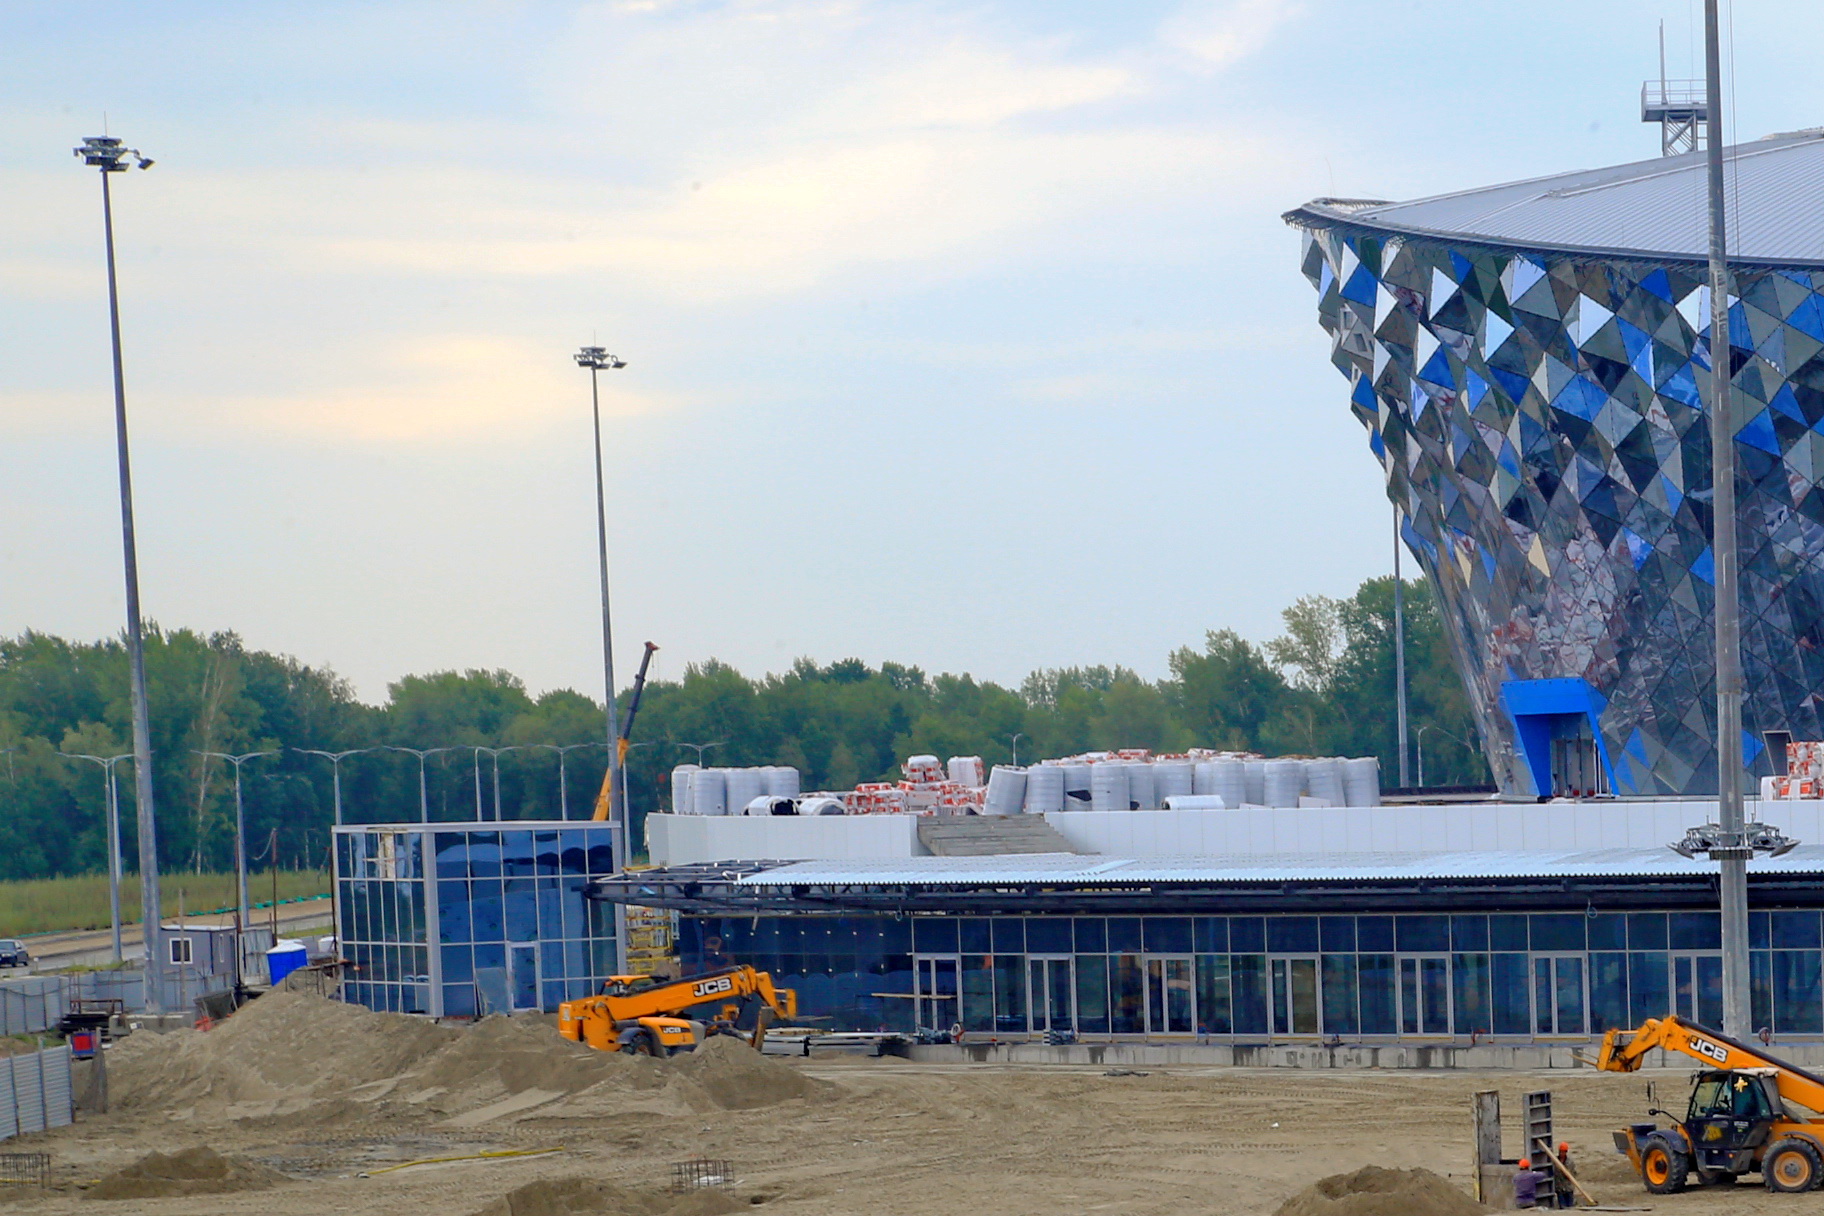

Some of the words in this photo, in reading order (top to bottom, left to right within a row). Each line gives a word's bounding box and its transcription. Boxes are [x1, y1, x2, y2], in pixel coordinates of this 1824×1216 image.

[694, 978, 732, 997] JCB
[663, 1026, 682, 1034] JCB
[1690, 1038, 1728, 1063] JCB
